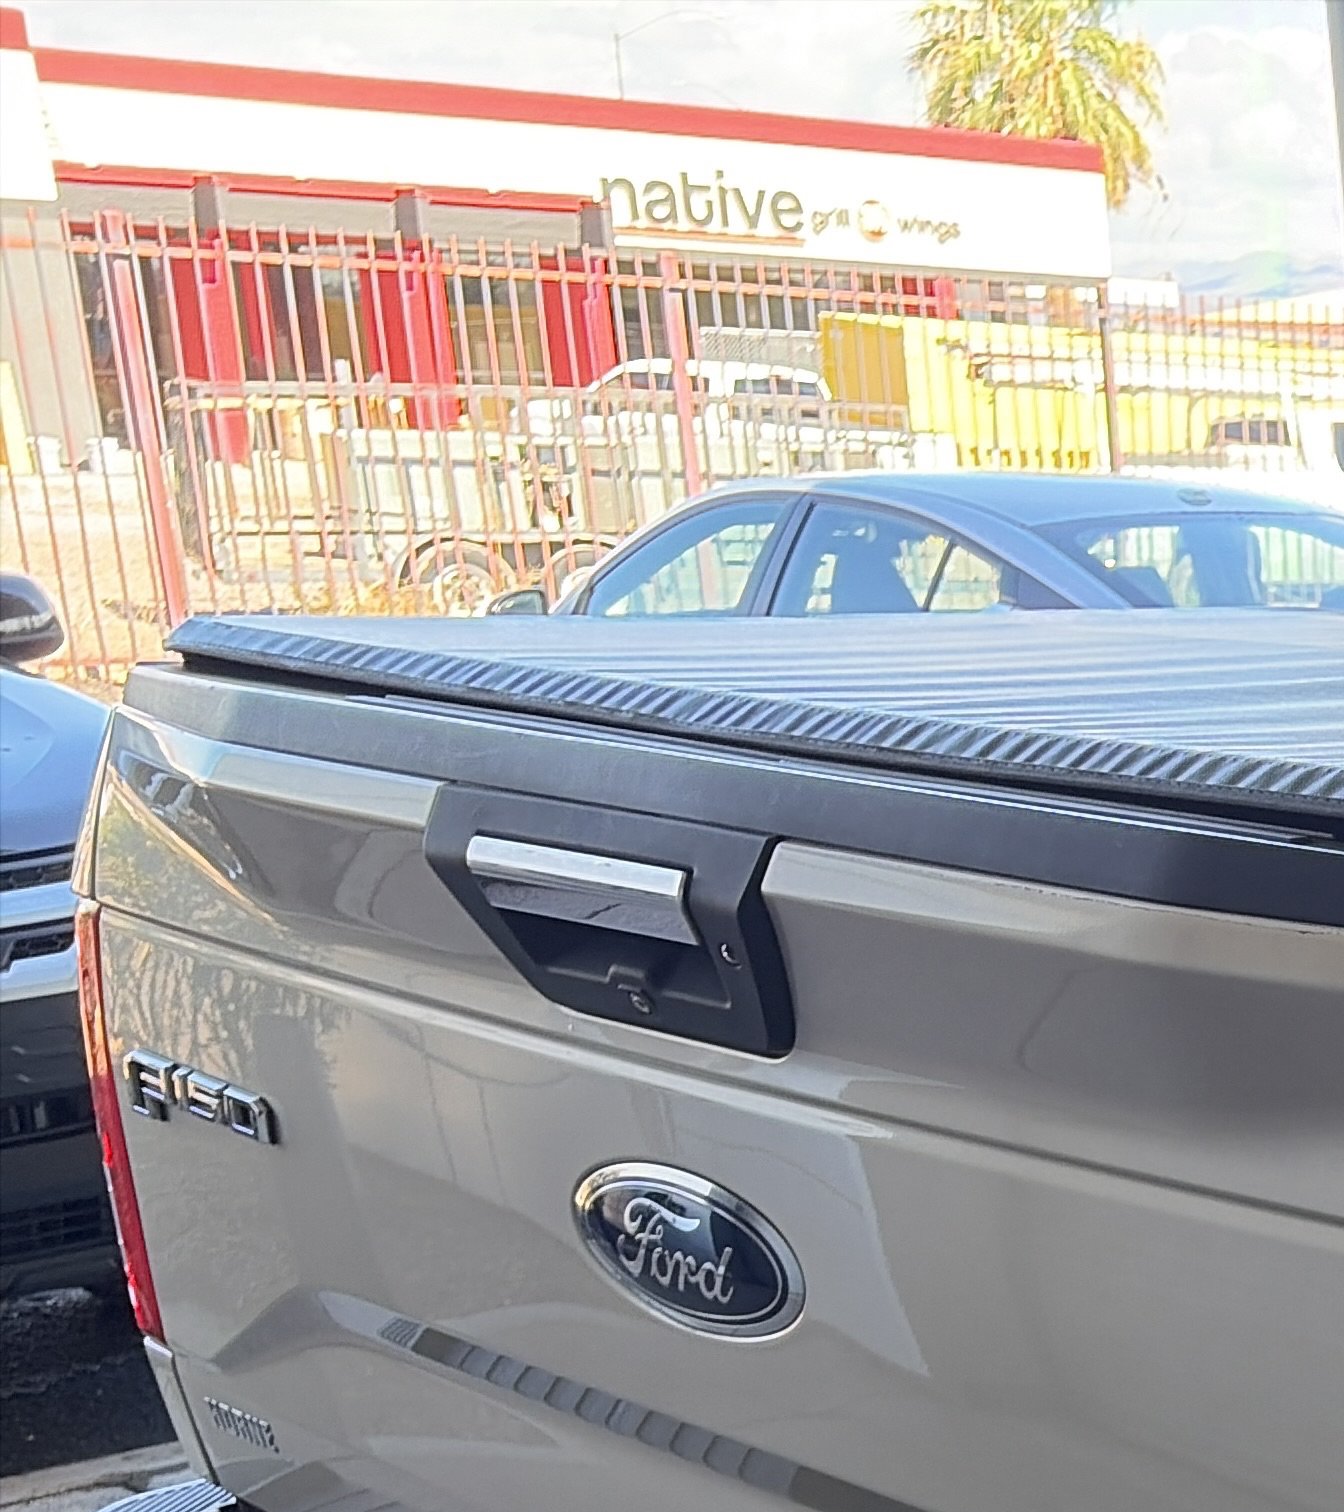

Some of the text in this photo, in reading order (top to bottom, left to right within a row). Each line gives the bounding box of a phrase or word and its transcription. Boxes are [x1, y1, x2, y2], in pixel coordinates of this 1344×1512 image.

[599, 170, 961, 244] native grill wings
[616, 1196, 736, 1305] Ford
